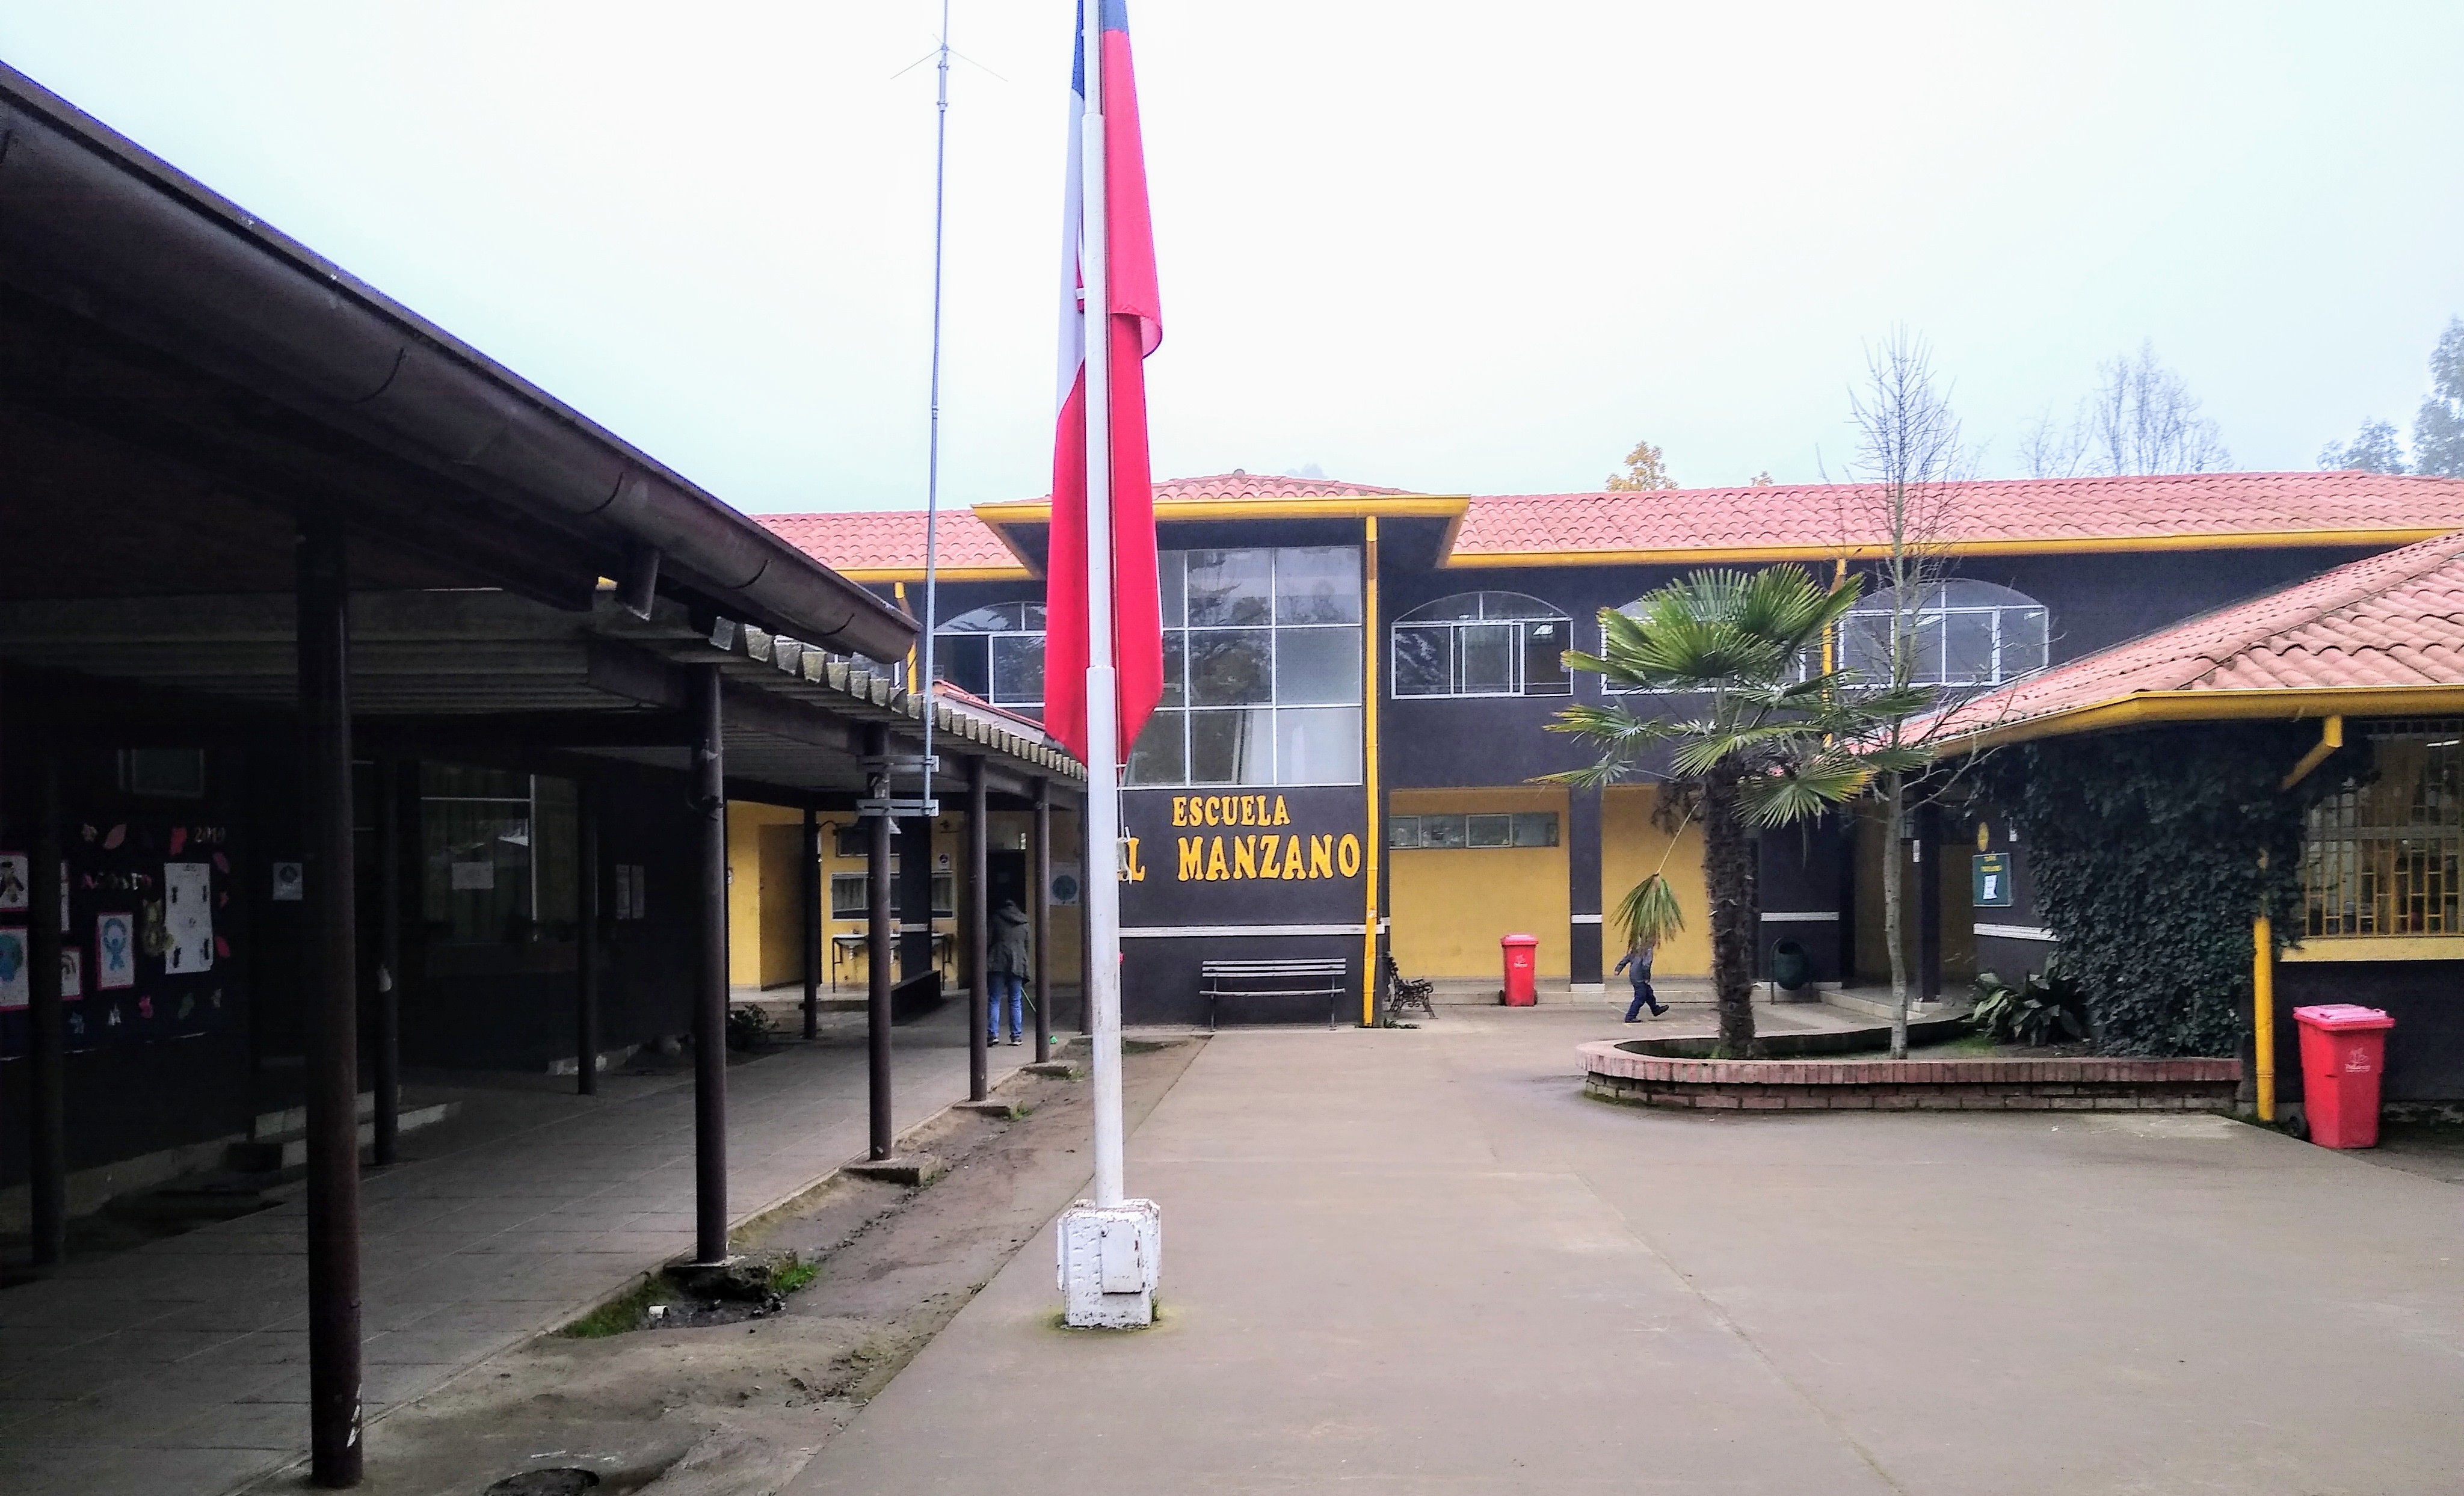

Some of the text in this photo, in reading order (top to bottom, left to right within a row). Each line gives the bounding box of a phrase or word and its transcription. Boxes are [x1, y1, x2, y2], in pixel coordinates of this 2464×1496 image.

[1172, 795, 1291, 826] ESCUELA
[1118, 833, 1361, 882] L MANZANO
